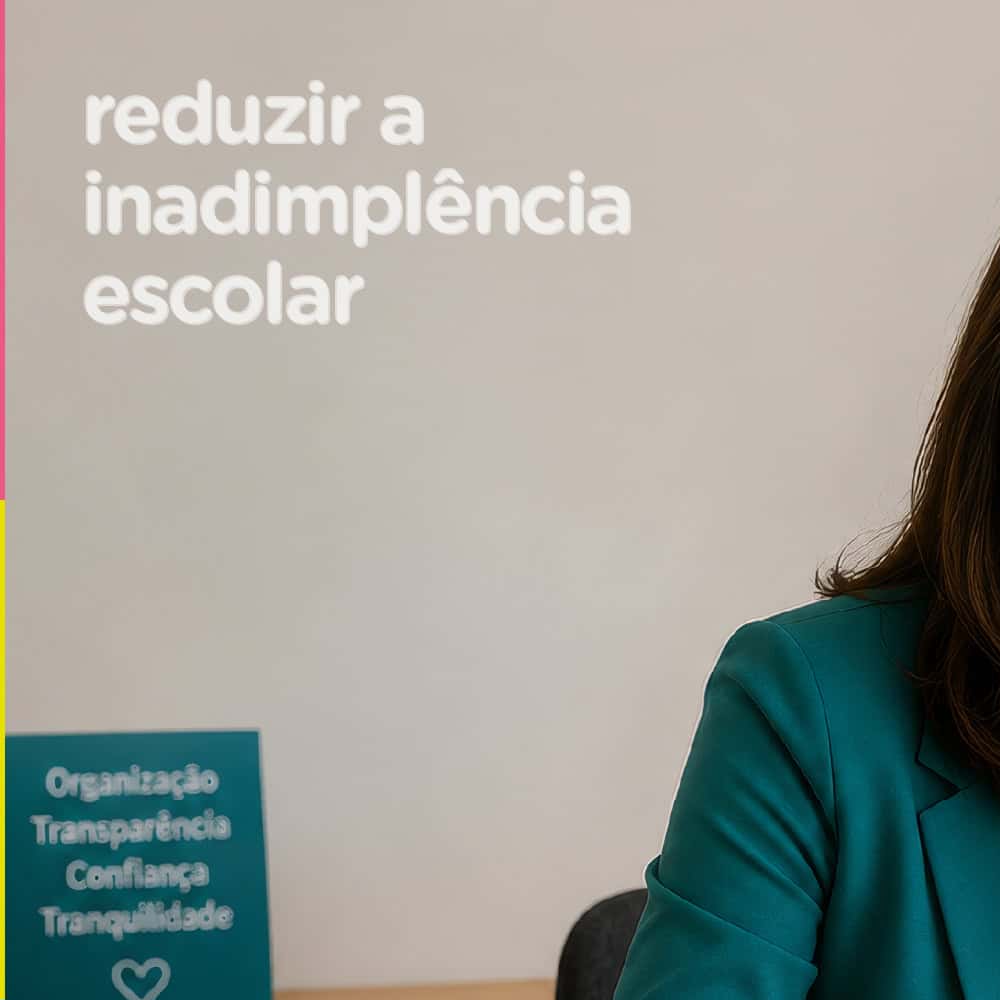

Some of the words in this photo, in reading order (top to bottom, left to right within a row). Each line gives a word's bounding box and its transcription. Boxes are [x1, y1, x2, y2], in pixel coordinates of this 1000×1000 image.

[45, 763, 220, 802] Organização
[30, 808, 231, 850] Transparência
[65, 856, 209, 893] Confiança
[38, 899, 235, 941] Tranquilidade
